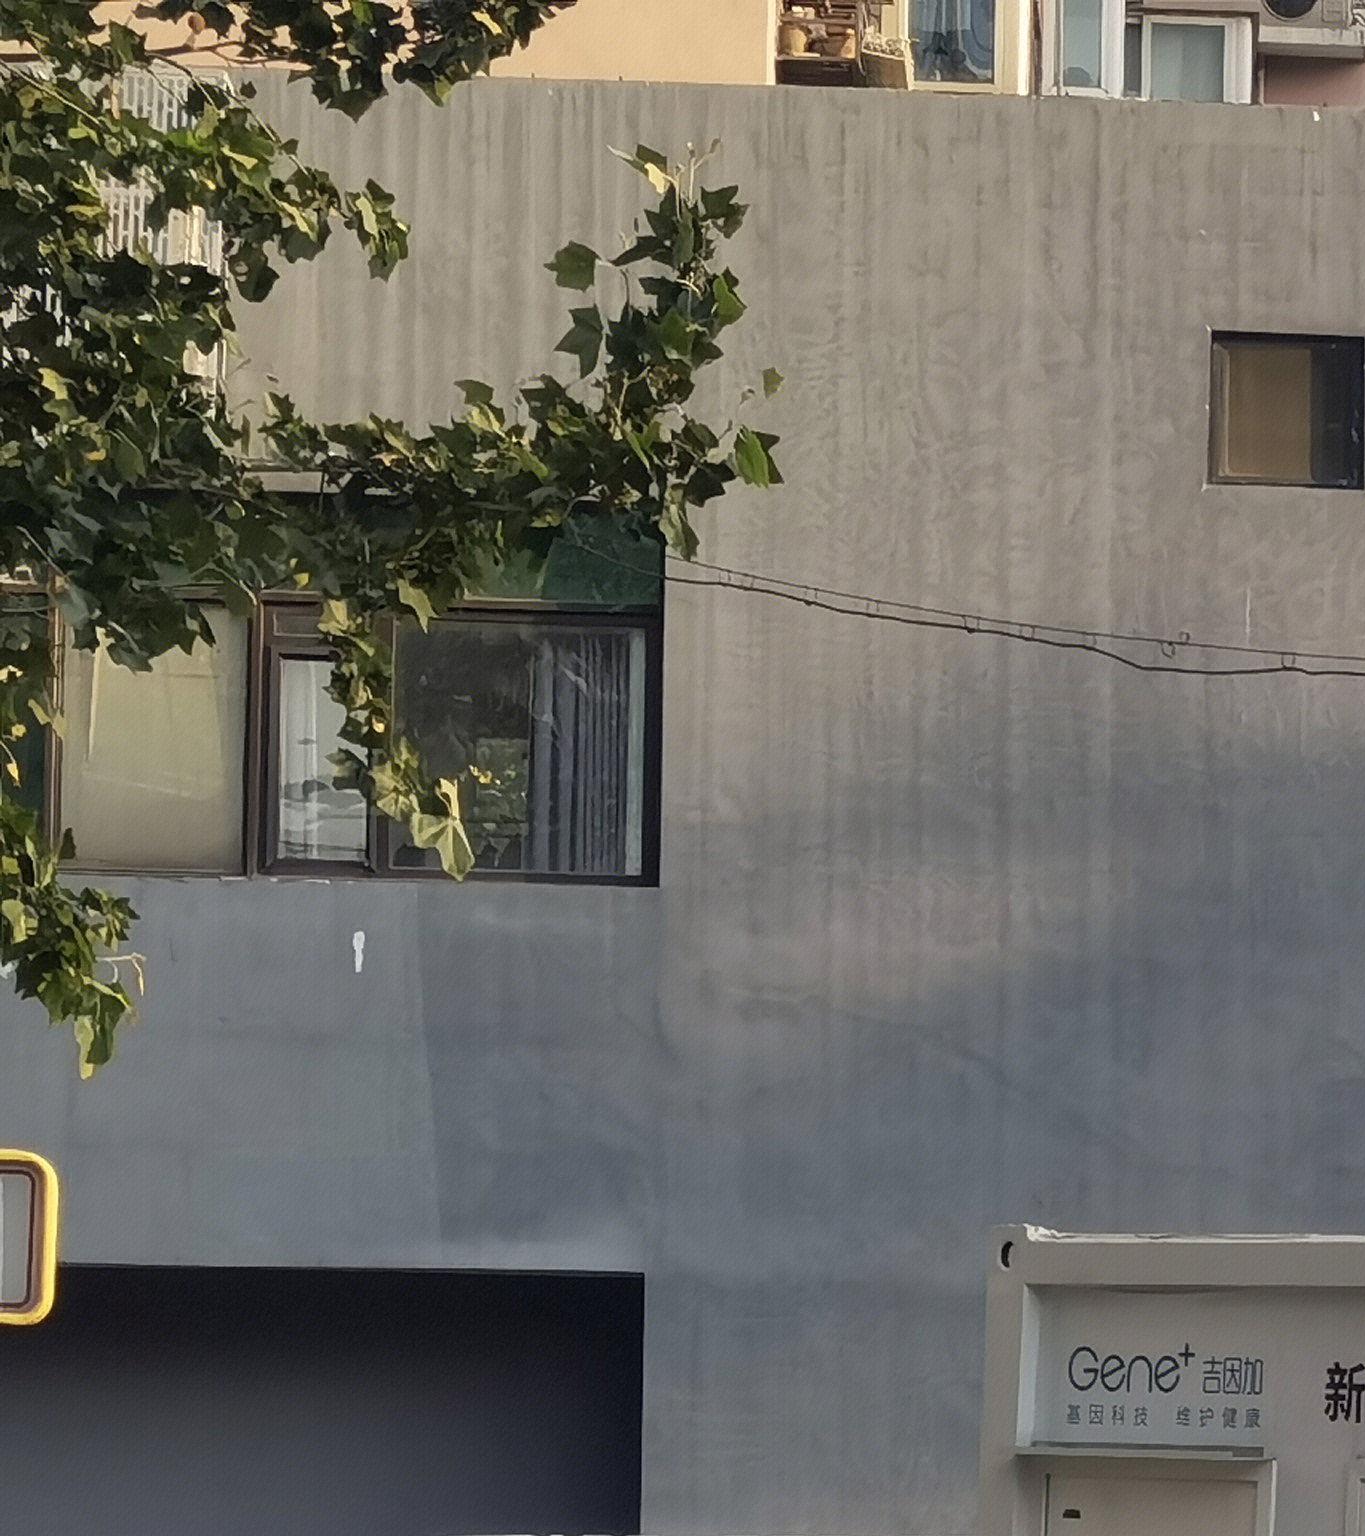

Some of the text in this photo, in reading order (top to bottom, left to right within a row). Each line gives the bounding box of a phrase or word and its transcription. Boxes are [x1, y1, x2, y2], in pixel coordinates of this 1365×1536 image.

[1202, 1356, 1264, 1395] 吉因加
[1066, 1404, 1261, 1428] 基因科技 维护健康
